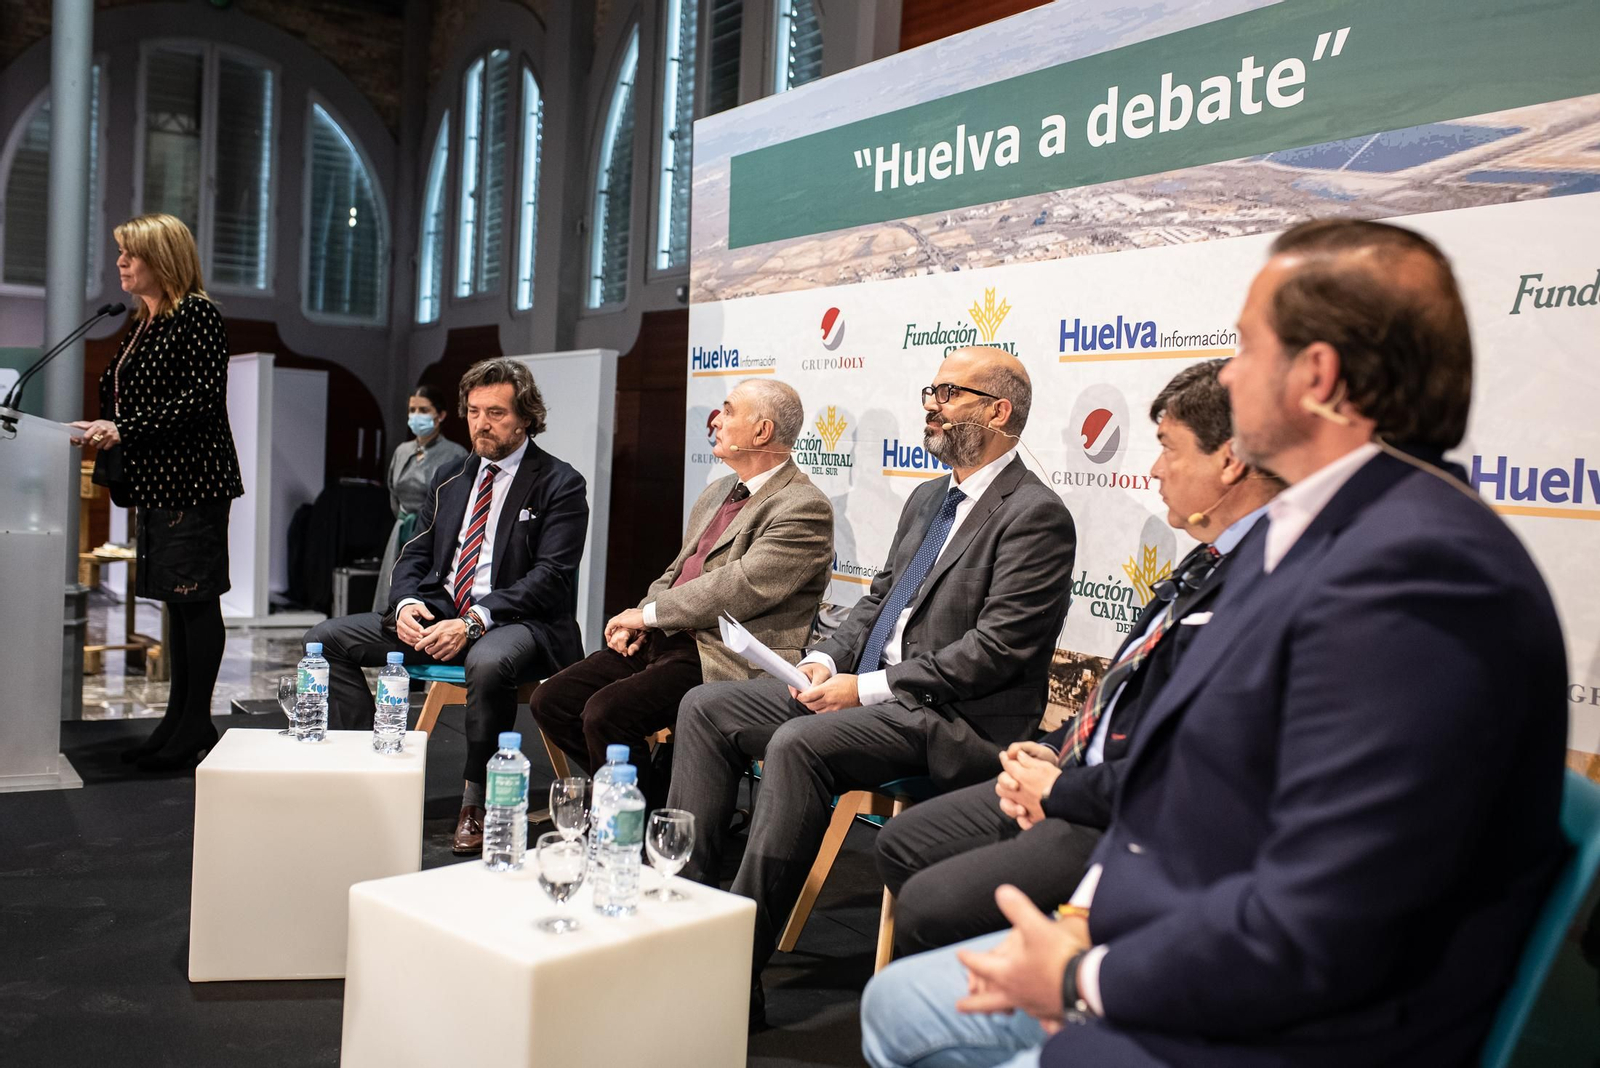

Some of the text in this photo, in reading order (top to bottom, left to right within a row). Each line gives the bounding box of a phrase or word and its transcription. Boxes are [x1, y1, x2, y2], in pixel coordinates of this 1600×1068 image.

[1038, 114, 1067, 158] a
[1509, 268, 1600, 315] Fund
[902, 320, 978, 350] Fundación
[1059, 315, 1237, 352] Huelva Información
[692, 345, 776, 371] Huelva Información
[691, 453, 723, 465] GRUPO
[797, 452, 853, 467] CAJA RURAL
[812, 466, 839, 476] DEL SUR
[1071, 570, 1134, 609] dación
[1090, 601, 1128, 621] CAJA
